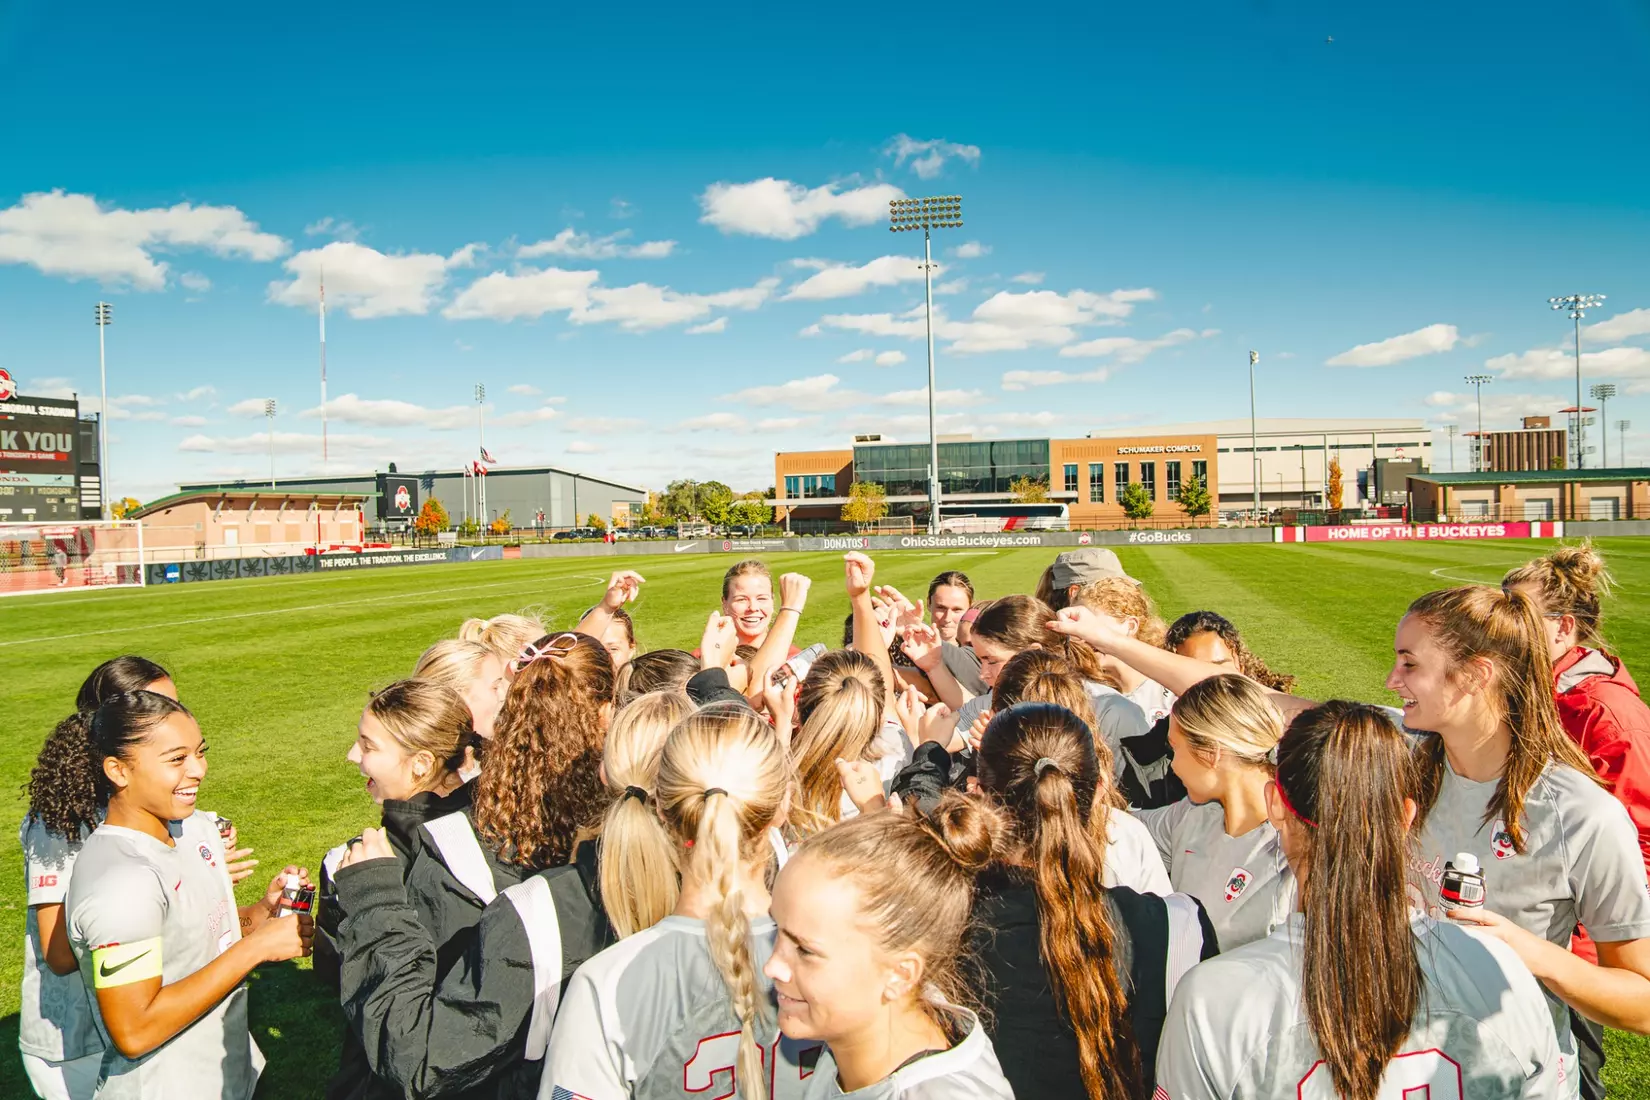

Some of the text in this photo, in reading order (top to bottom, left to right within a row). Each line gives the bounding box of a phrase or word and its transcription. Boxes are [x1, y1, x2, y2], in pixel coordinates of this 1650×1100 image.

[0, 403, 38, 415] EMORIAL
[23, 431, 72, 452] YOU
[1118, 445, 1202, 454] SCHUMAKER COMPLEX
[1128, 532, 1192, 543] #GoBucks
[1328, 527, 1369, 539] HOME
[1371, 527, 1391, 538] OF
[1428, 525, 1506, 537] BUCKEYES
[823, 538, 863, 549] DONATOS
[900, 535, 1041, 547] OhioStateBuckeyes.com
[320, 559, 333, 567] THE
[334, 558, 359, 567] PEOPLE.
[359, 557, 372, 565] THE
[372, 556, 402, 564] TRADITION.
[415, 552, 447, 561] EXCELLENCE.
